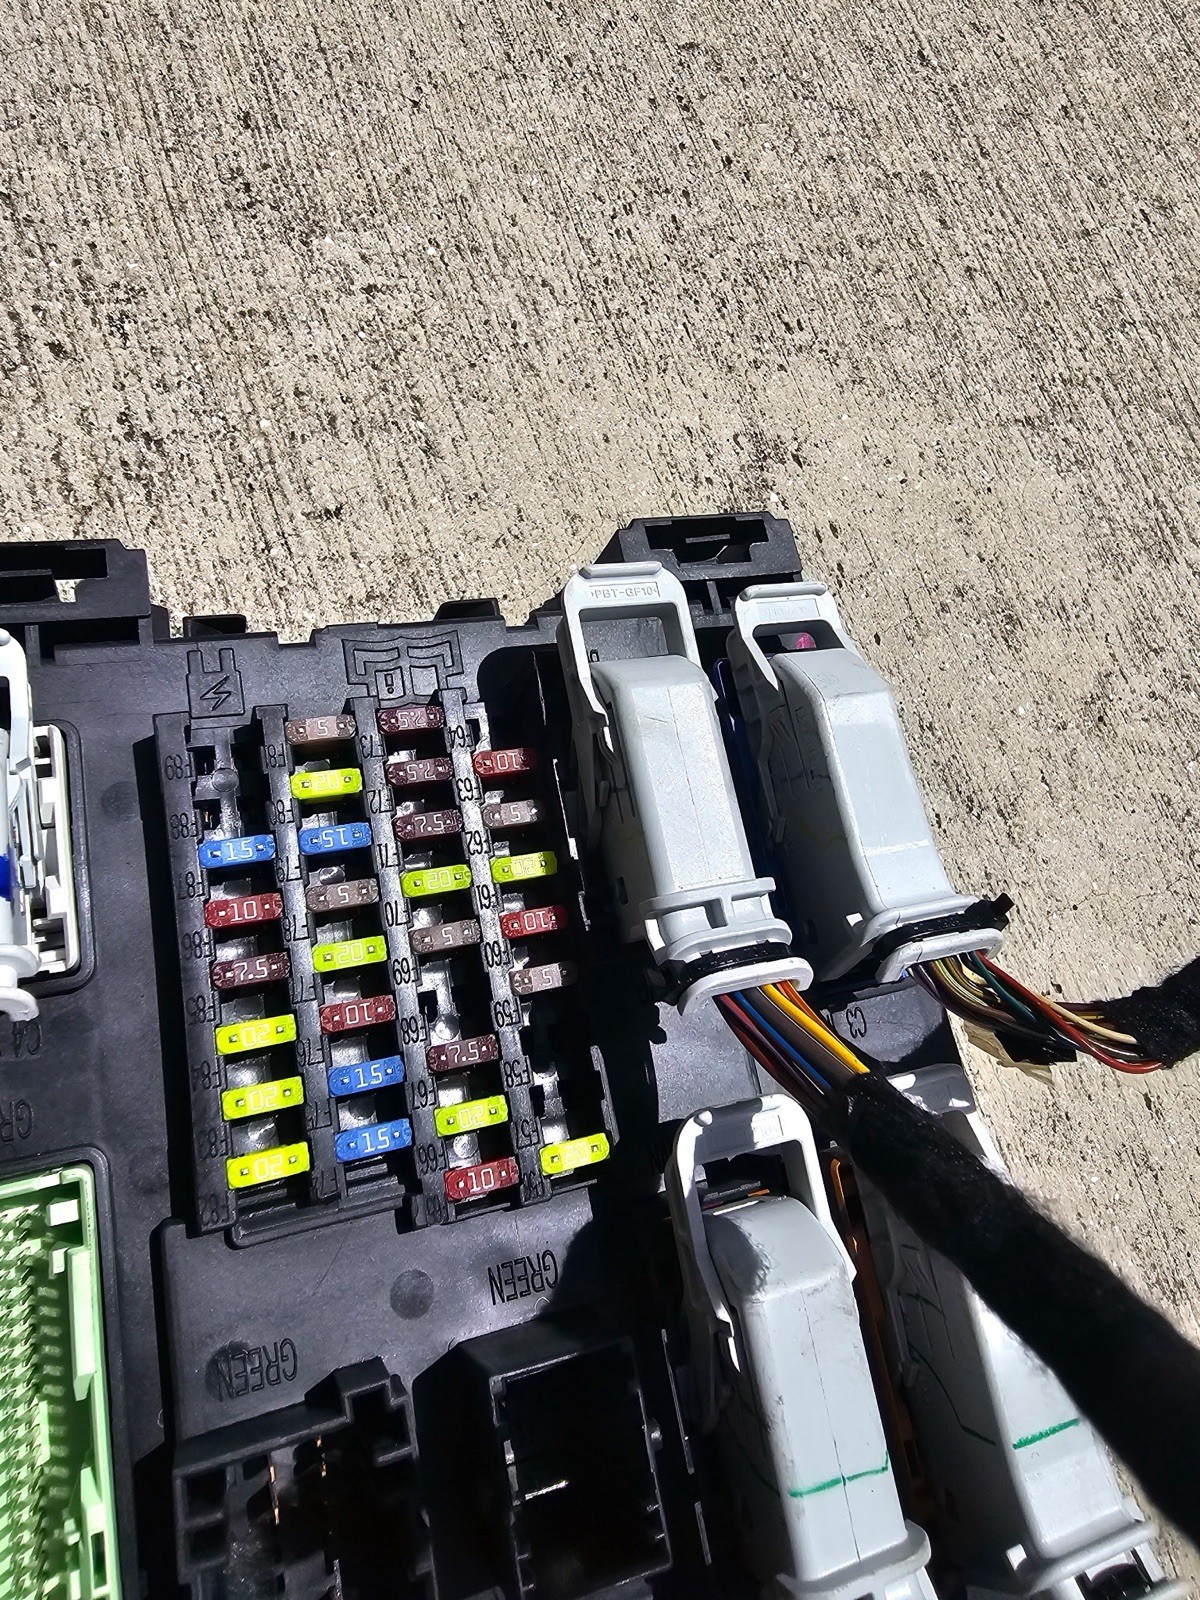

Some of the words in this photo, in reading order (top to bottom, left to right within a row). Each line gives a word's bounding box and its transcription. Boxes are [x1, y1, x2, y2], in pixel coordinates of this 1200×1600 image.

[317, 720, 328, 735] 5
[397, 711, 426, 729] 7.5
[359, 735, 385, 758] F73
[450, 725, 473, 747] F64
[165, 754, 193, 781] F89
[407, 763, 436, 781] 7.5
[497, 753, 518, 769] 10
[313, 772, 339, 790] 20
[458, 778, 480, 802] F63
[369, 789, 393, 814] F72
[511, 805, 521, 821] 5
[171, 811, 199, 839] F88
[414, 814, 445, 833] 7.5
[321, 827, 349, 848] 15
[467, 830, 490, 855] F62
[226, 840, 253, 860] 15
[378, 844, 400, 868] F71
[276, 855, 302, 881] F79
[511, 857, 536, 876] 20
[179, 871, 204, 899] F87
[425, 871, 450, 889] 20
[338, 885, 350, 903] 5
[477, 884, 499, 910] F61
[230, 901, 257, 922] 10
[385, 901, 409, 927] F70
[524, 912, 546, 931] 10
[283, 914, 309, 942] F78
[442, 927, 453, 945] 5
[182, 931, 213, 959] F86
[336, 940, 364, 964] 20
[484, 941, 511, 967] F60
[234, 960, 268, 979] 7.5
[392, 958, 420, 985] F69
[542, 969, 553, 986] 5
[345, 1003, 372, 1025] 10
[495, 1000, 521, 1028] F59
[845, 1006, 867, 1039] C3
[240, 1024, 270, 1048] 20
[401, 1016, 428, 1045] F68
[448, 1041, 480, 1063] 7.5
[355, 1063, 382, 1088] 15
[504, 1059, 531, 1088] F58
[249, 1088, 279, 1112] 20
[410, 1080, 437, 1111] F67
[457, 1105, 485, 1129] 20
[361, 1127, 390, 1153] 15
[253, 1155, 283, 1179] 20
[419, 1145, 448, 1175] F66
[467, 1168, 495, 1192] 10
[487, 1249, 558, 1305] GREEN
[216, 1338, 297, 1400] GREEN
